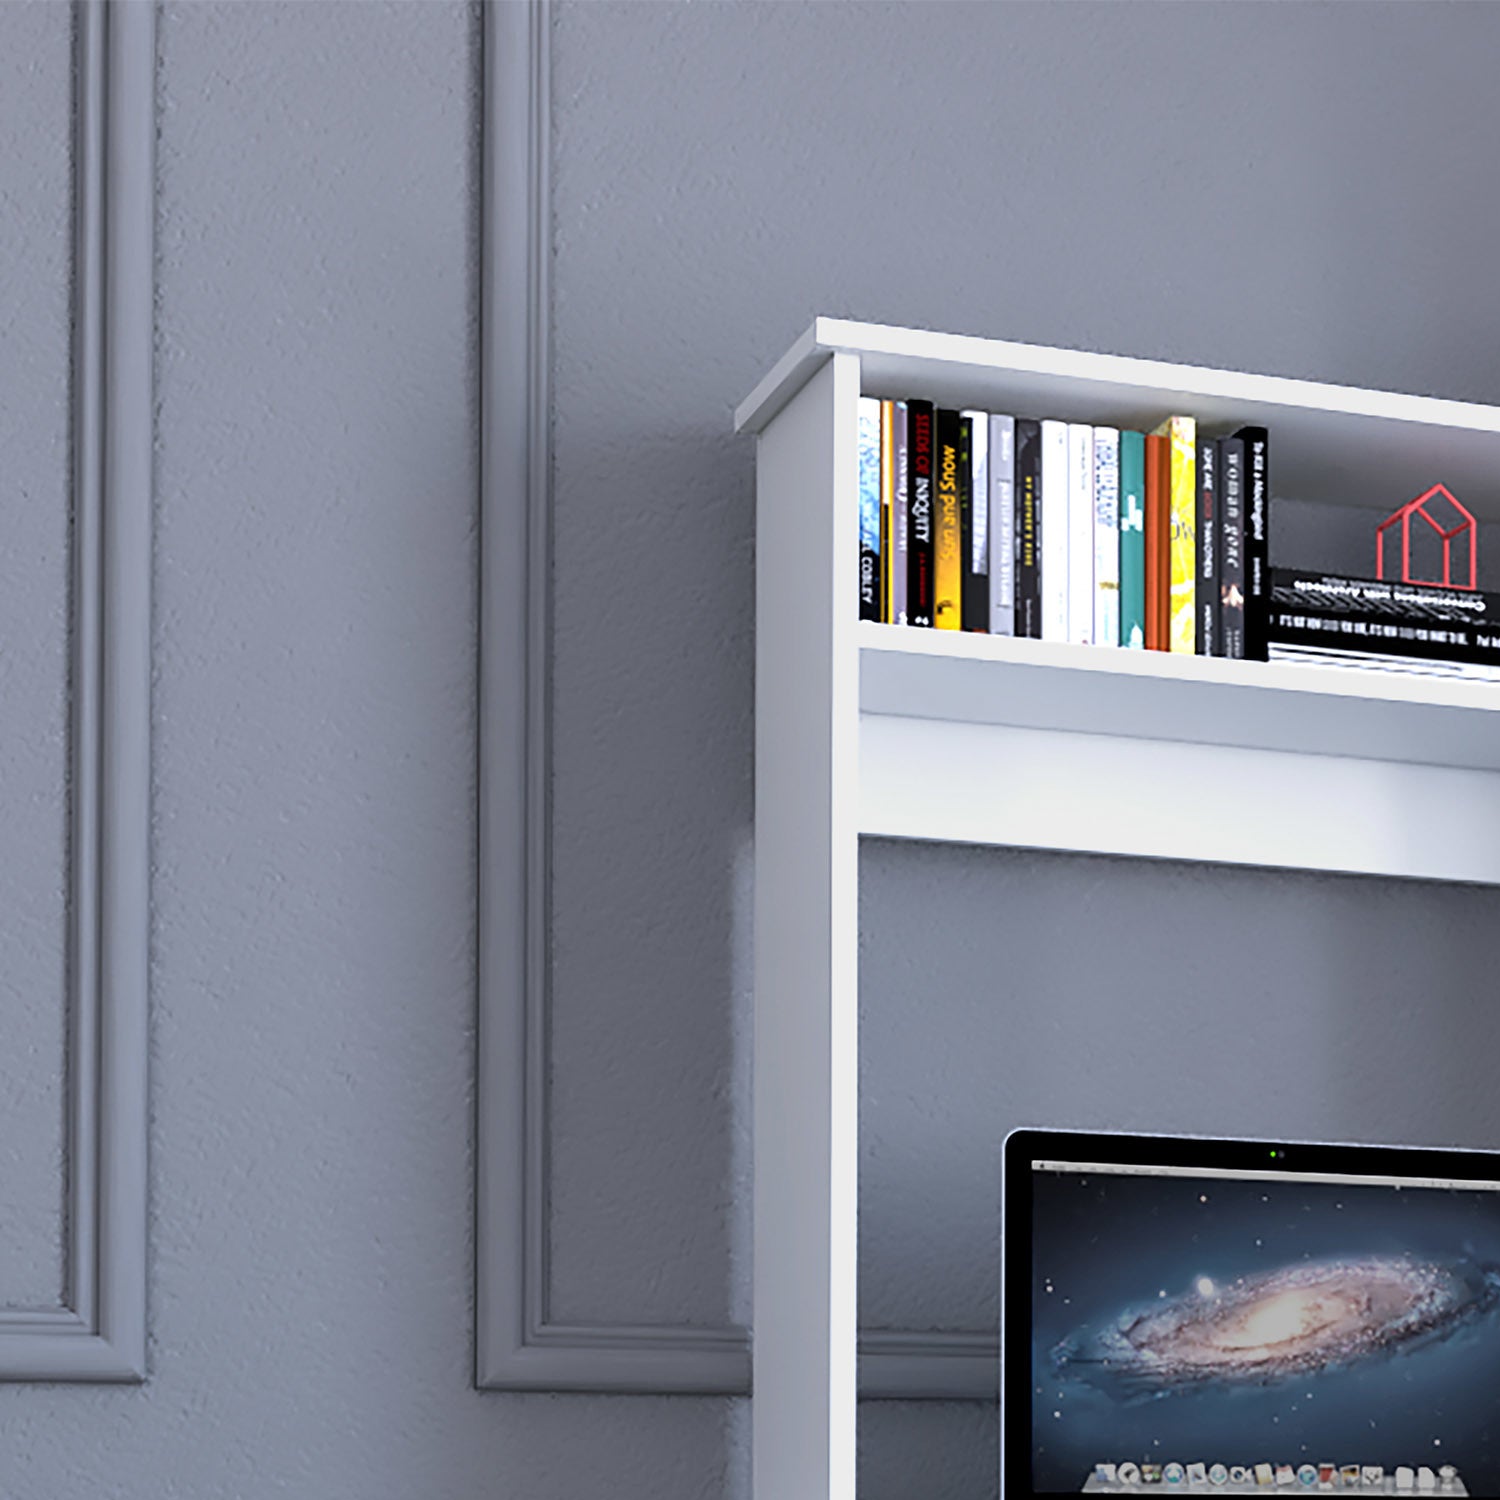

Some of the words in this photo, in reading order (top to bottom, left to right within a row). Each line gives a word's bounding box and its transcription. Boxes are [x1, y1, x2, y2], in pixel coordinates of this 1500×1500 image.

[915, 414, 930, 454] SEEDS
[939, 445, 956, 491] Snow
[911, 477, 931, 544] INIQUITY
[939, 495, 956, 526] and
[939, 530, 954, 559] Sun
